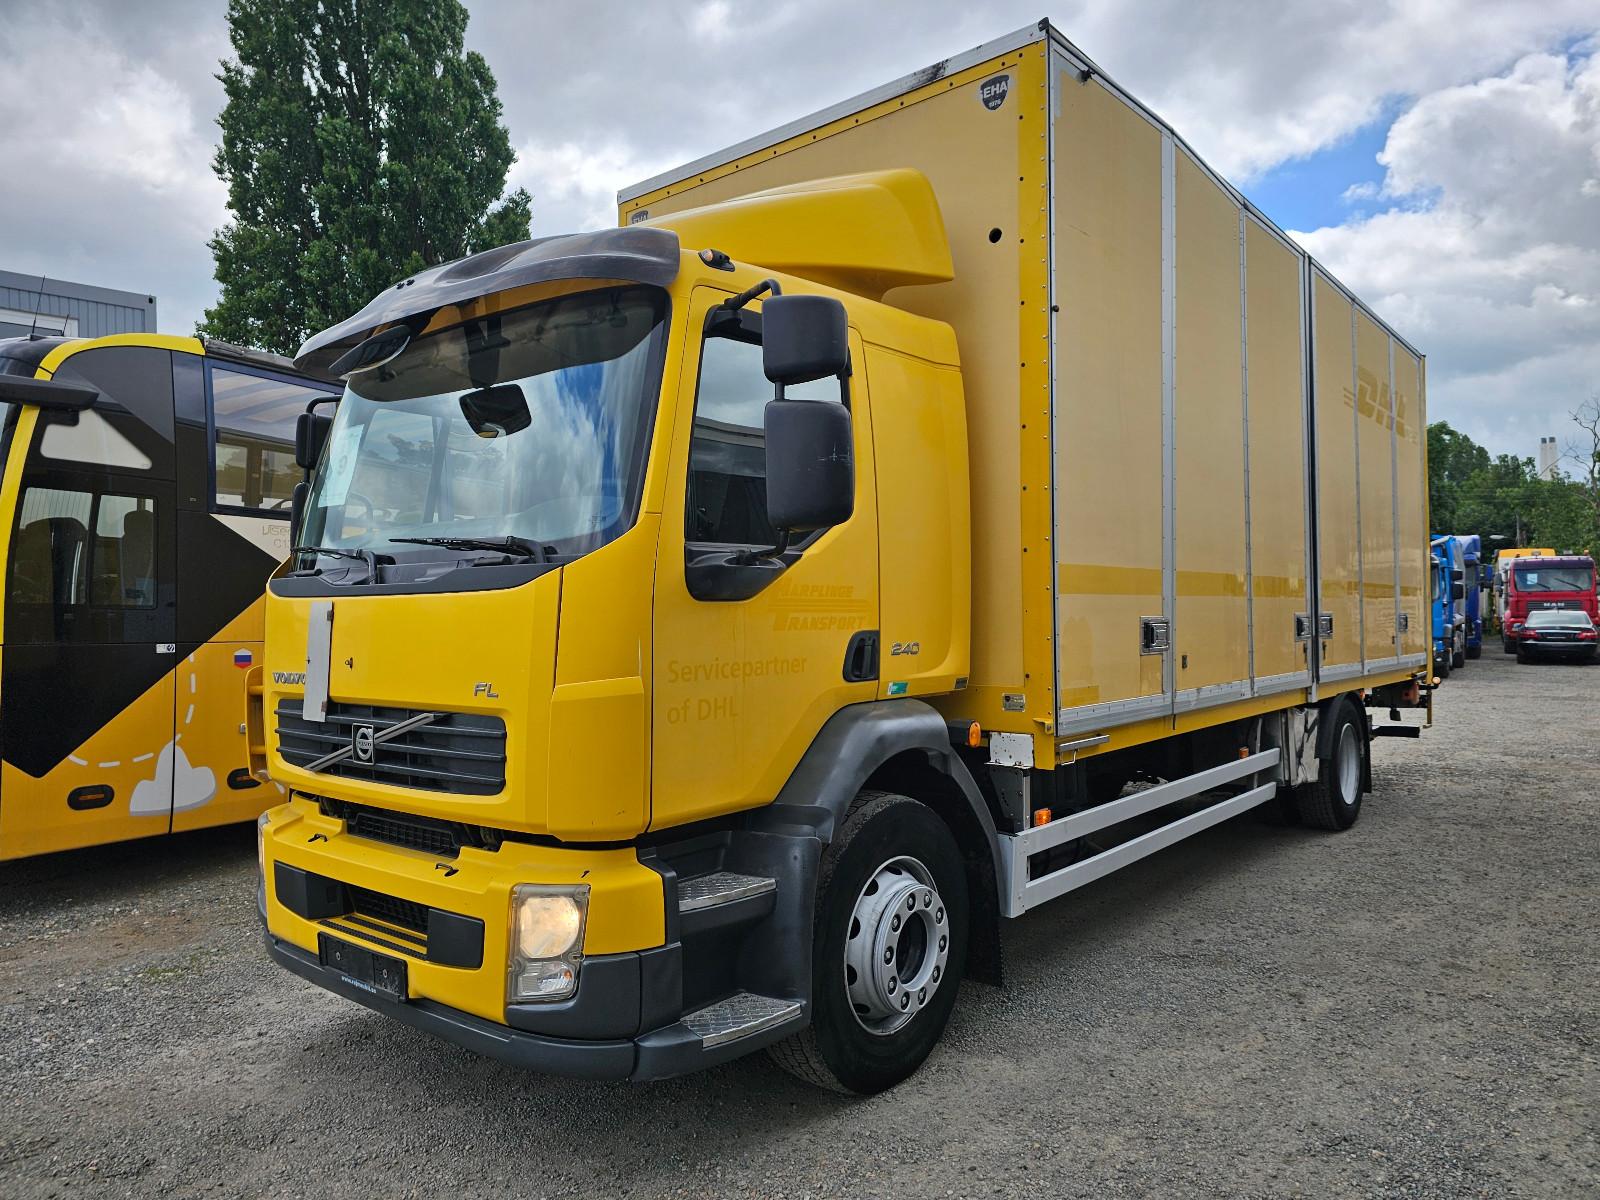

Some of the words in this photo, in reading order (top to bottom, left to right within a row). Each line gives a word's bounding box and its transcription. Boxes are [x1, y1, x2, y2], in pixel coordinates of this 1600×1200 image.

[890, 642, 920, 656] 240
[667, 656, 808, 688] Servicepartner
[474, 682, 499, 698] FL
[666, 697, 690, 724] of
[698, 696, 739, 721] DHL
